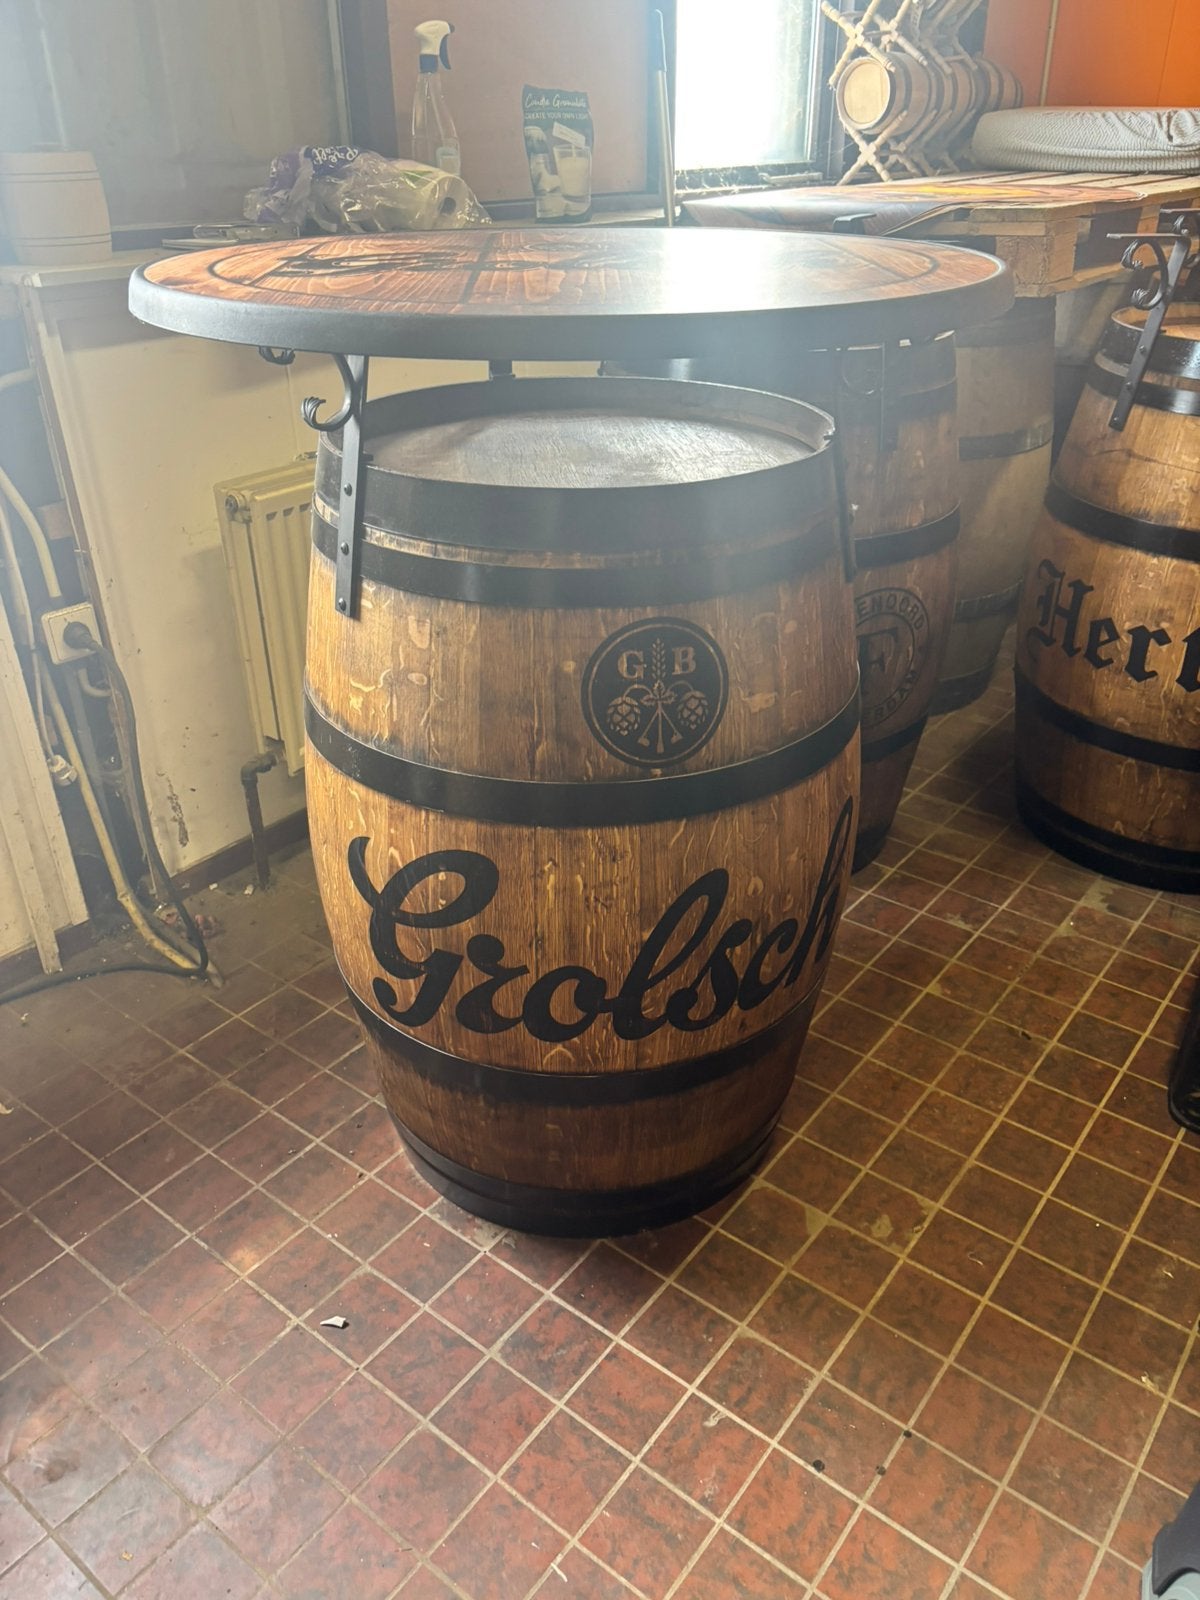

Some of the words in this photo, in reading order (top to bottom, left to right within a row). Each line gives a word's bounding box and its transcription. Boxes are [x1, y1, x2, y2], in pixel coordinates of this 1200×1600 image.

[547, 111, 561, 120] YOUR
[562, 111, 574, 120] OWN
[617, 650, 647, 680] G
[671, 646, 697, 676] B
[347, 795, 853, 1043] Grolsch
